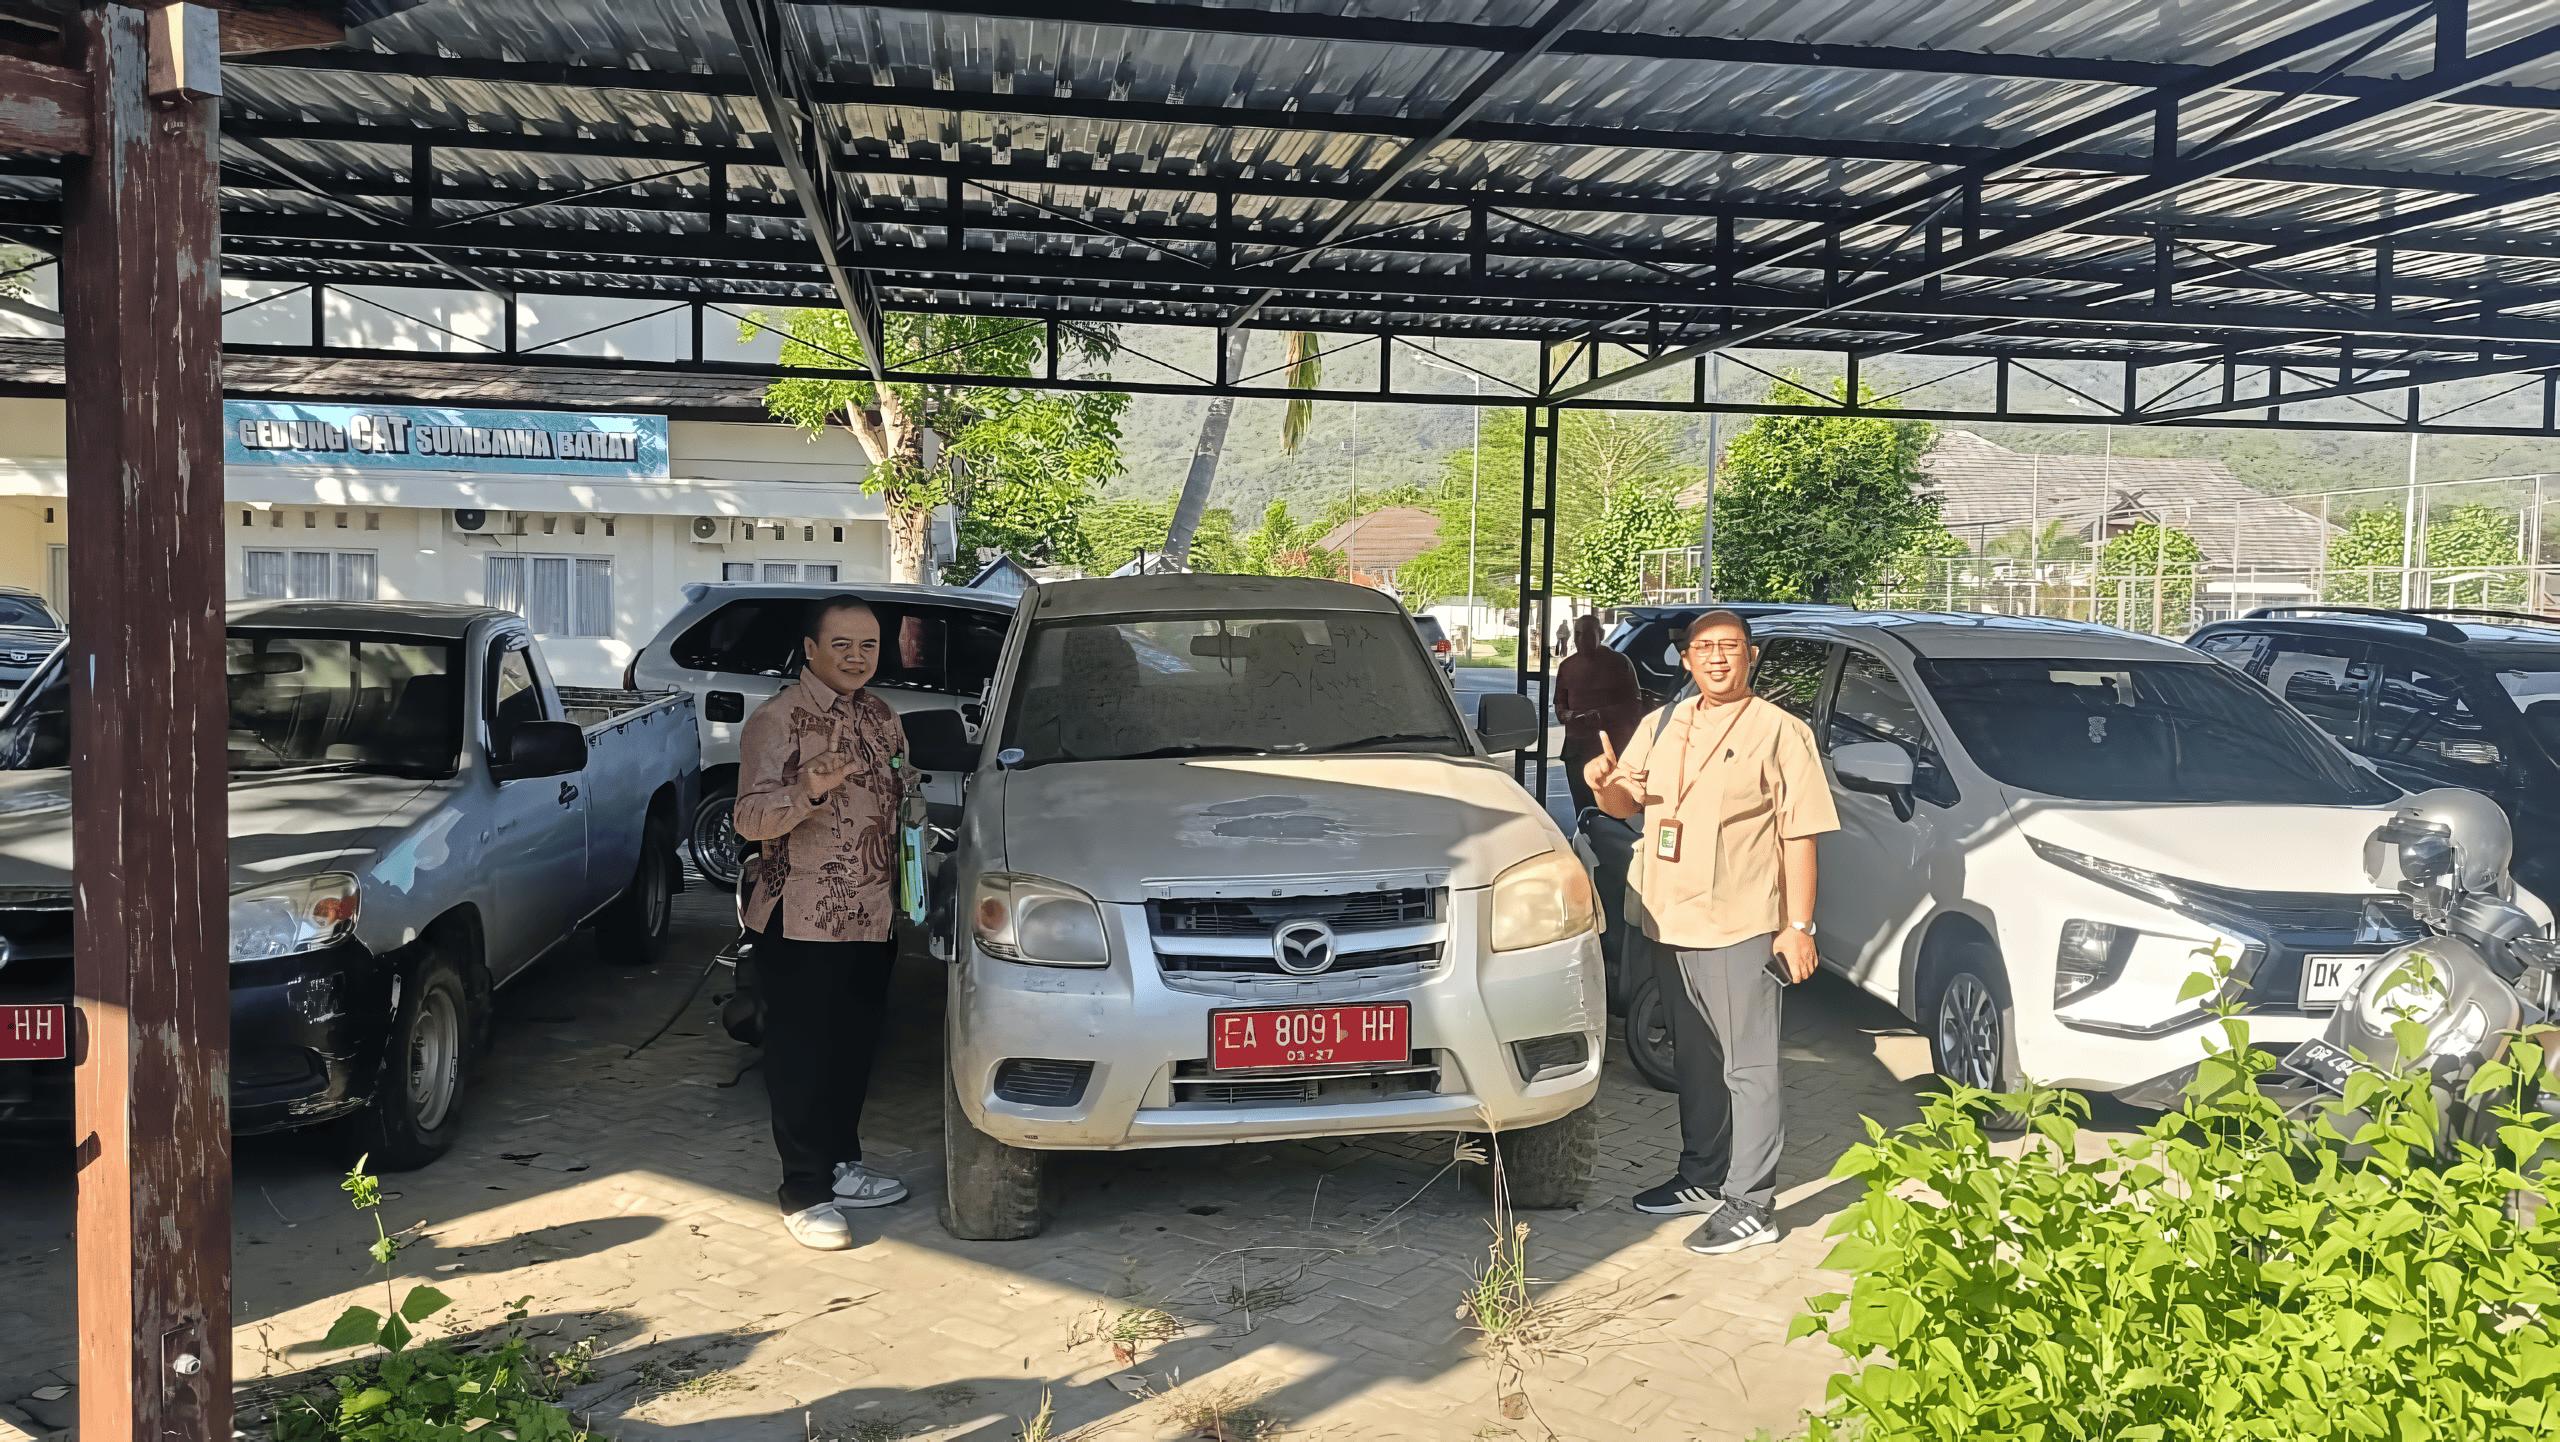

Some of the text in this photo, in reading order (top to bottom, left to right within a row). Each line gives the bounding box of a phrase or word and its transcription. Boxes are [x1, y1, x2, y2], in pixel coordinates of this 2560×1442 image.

[239, 415, 637, 460] GEDUNG CAT SUMBAWA BARAT
[2313, 963, 2342, 987] DK
[15, 1009, 51, 1040] HH
[1224, 1010, 1394, 1048] EA 8091 HH
